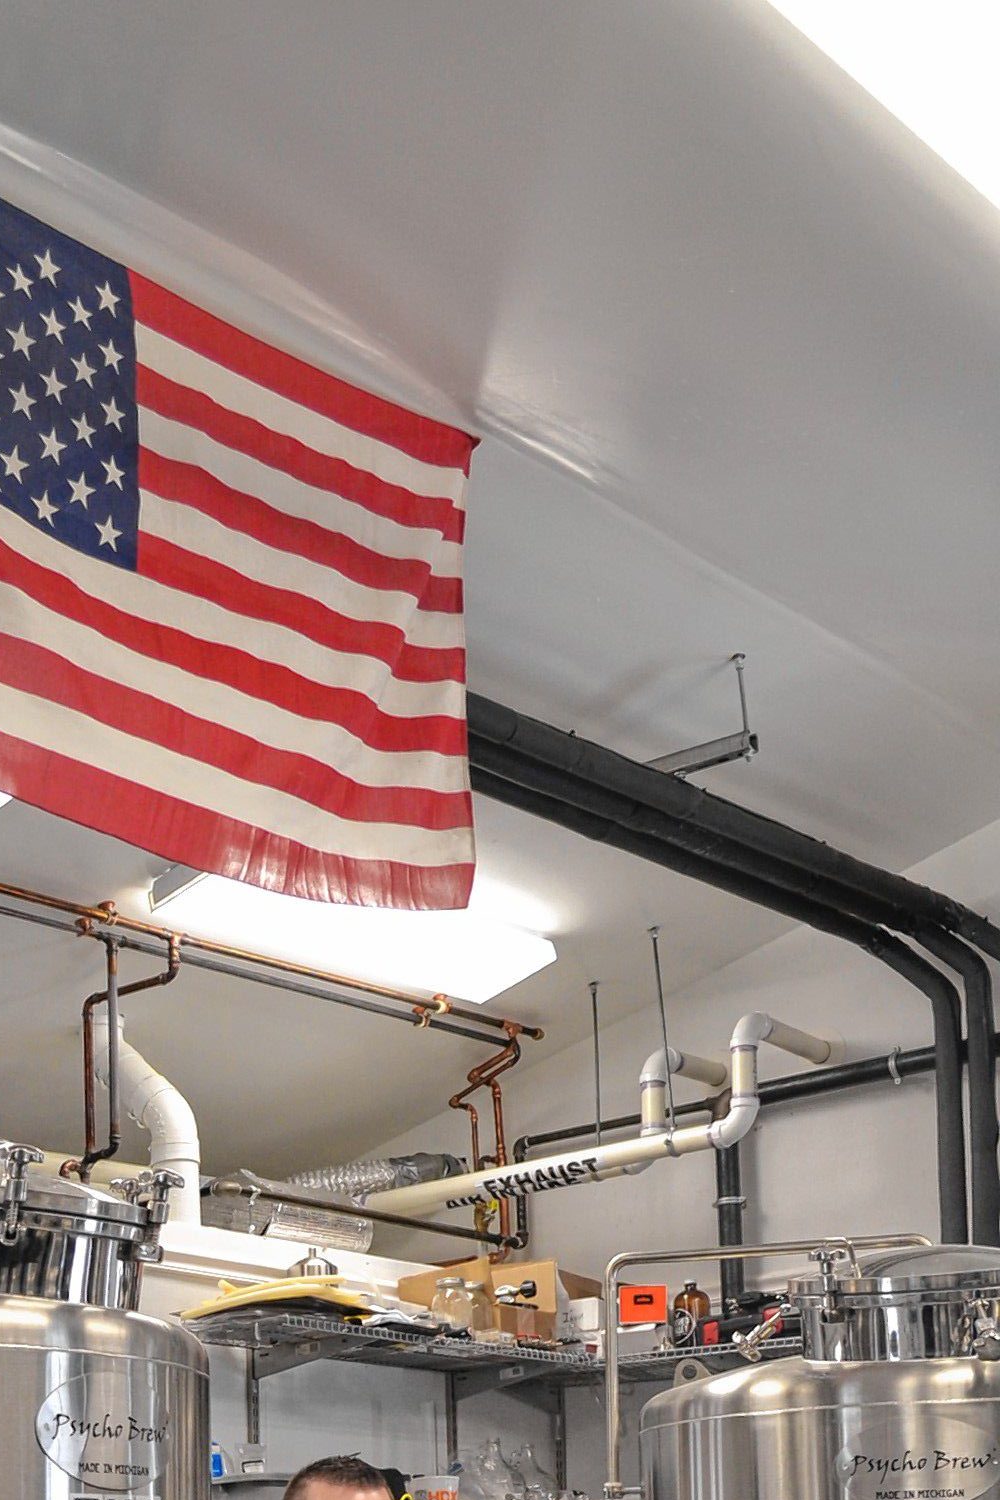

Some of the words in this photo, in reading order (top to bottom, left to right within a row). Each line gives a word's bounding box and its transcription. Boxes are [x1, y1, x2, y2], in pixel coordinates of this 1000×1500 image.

[483, 1157, 598, 1199] EXHAUST
[51, 1412, 124, 1446] Psycho
[127, 1416, 168, 1444] Brew
[78, 1462, 100, 1473] MADE
[103, 1463, 113, 1473] IN
[850, 1450, 928, 1485] Psycho
[933, 1450, 992, 1472] Brew
[875, 1490, 900, 1500] MADE
[903, 1490, 915, 1499] IN
[917, 1488, 965, 1499] MICHIGAN
